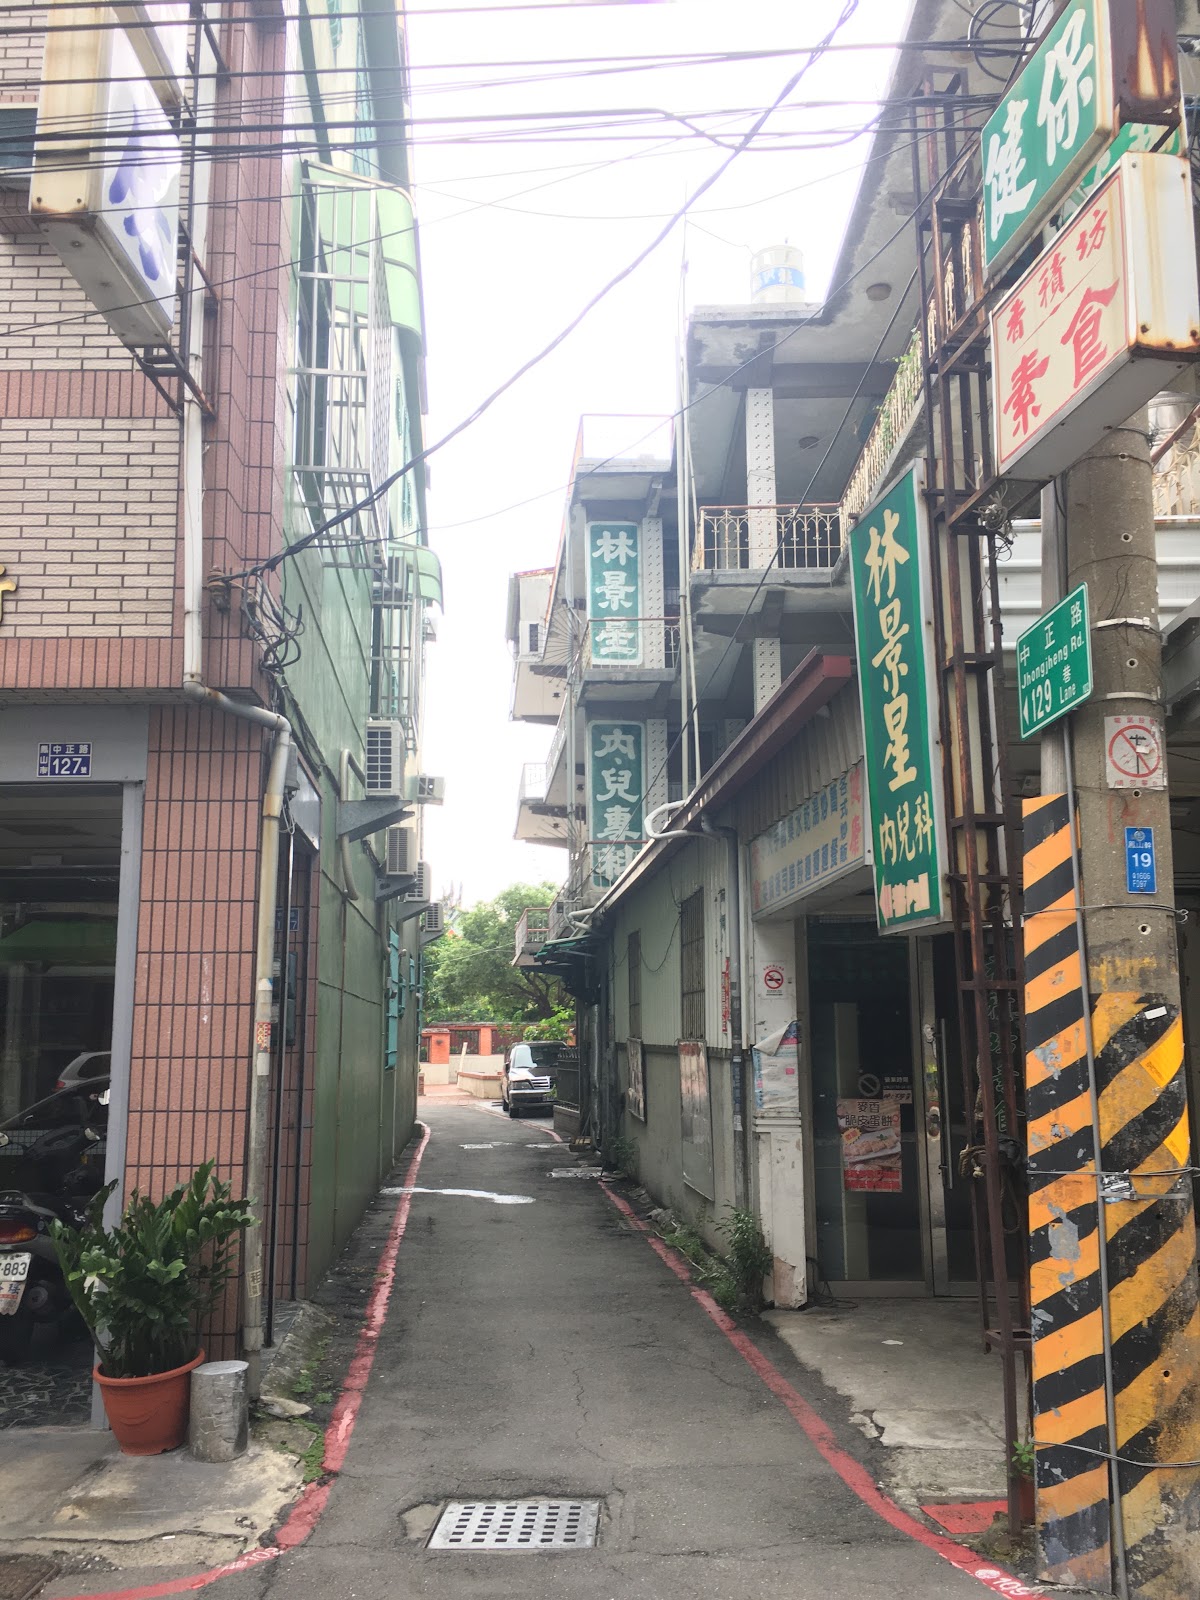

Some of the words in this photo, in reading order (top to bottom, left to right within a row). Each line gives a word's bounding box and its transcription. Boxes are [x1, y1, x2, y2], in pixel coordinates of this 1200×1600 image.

[984, 8, 1094, 242] 健保
[1003, 276, 1121, 438] 素食
[591, 530, 638, 656] 林景星
[863, 508, 918, 793] 林景星
[1020, 600, 1082, 667] 中正路
[1021, 644, 1069, 690] Jhongjheng
[1070, 630, 1085, 653] Rd.
[1062, 664, 1071, 684] 巷
[1031, 678, 1052, 722] 129
[1059, 682, 1076, 704] Lane
[52, 744, 89, 755] 中正路
[1131, 852, 1152, 868] 19
[845, 1115, 893, 1127] 脆皮蛋餅
